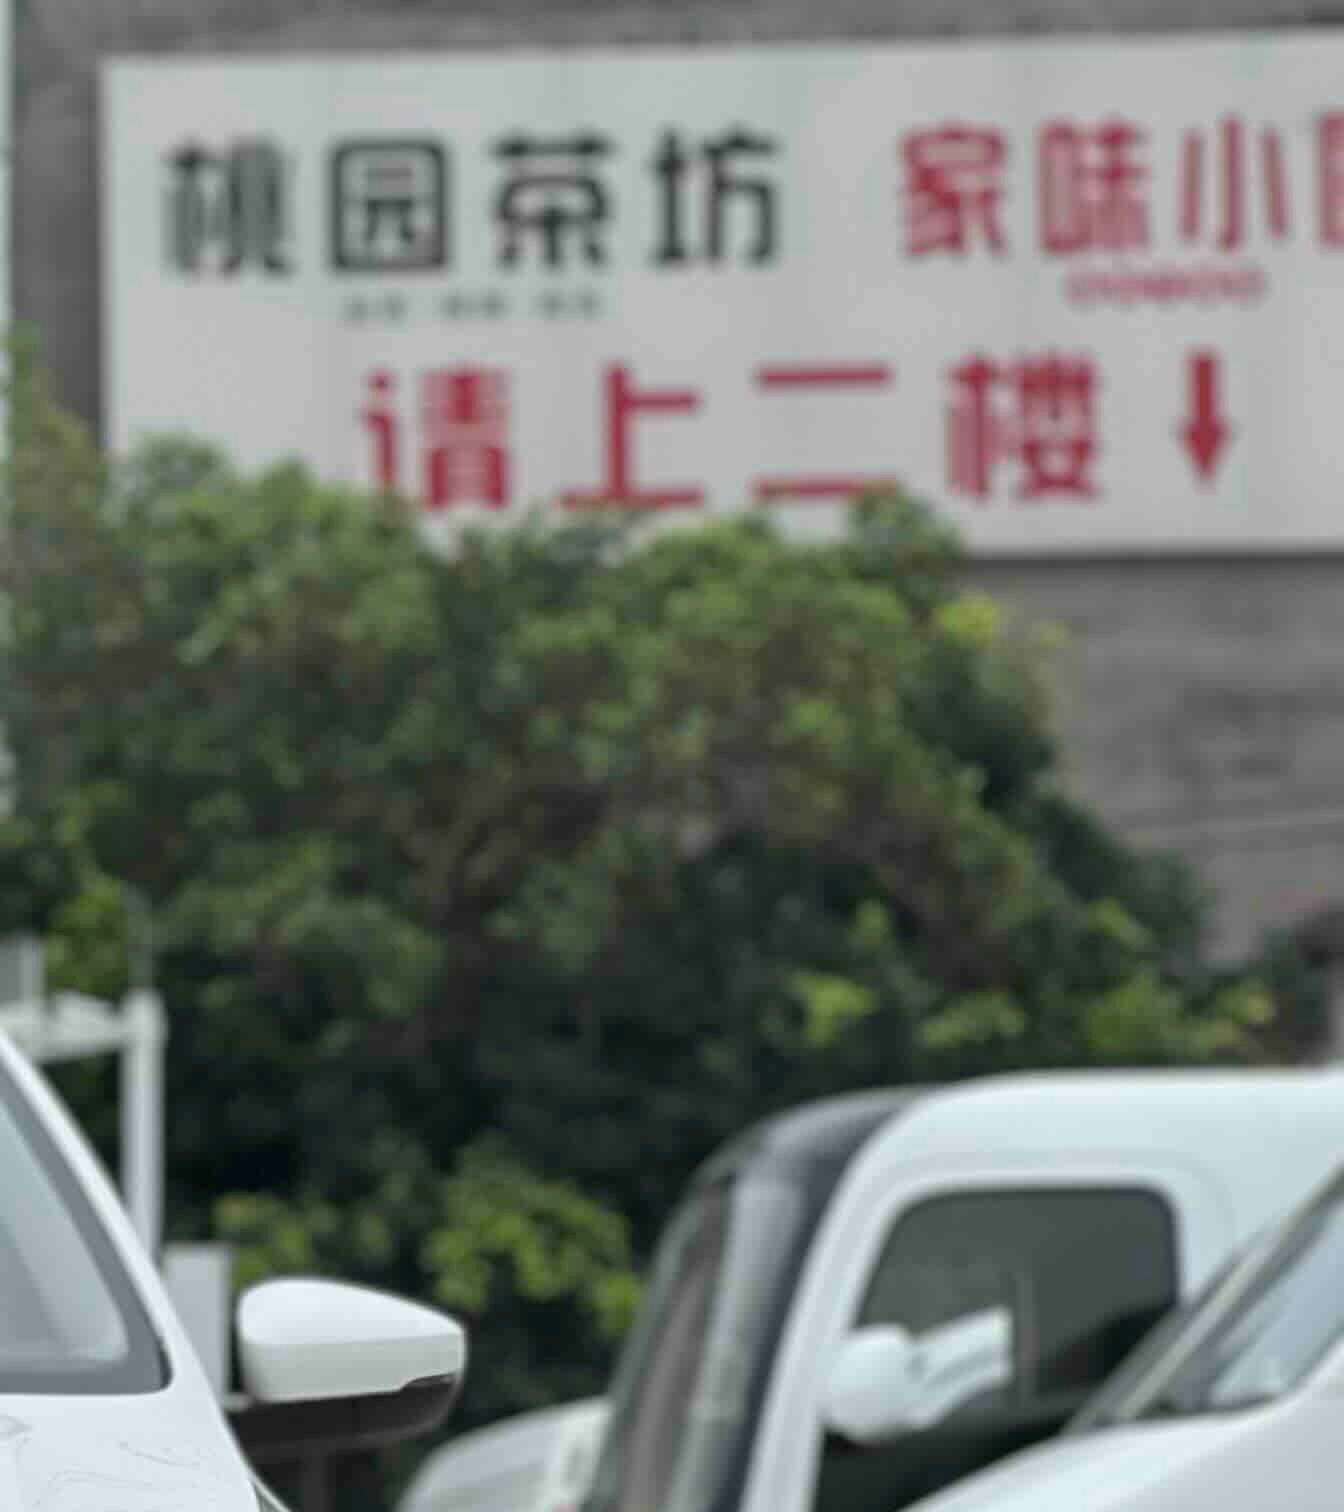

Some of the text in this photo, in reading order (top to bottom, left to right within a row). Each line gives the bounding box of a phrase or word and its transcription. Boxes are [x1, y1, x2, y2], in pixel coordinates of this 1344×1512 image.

[164, 128, 780, 277] 桃园茶坊
[895, 108, 1344, 262] 家味小
[362, 350, 1098, 512] 请上二楼
